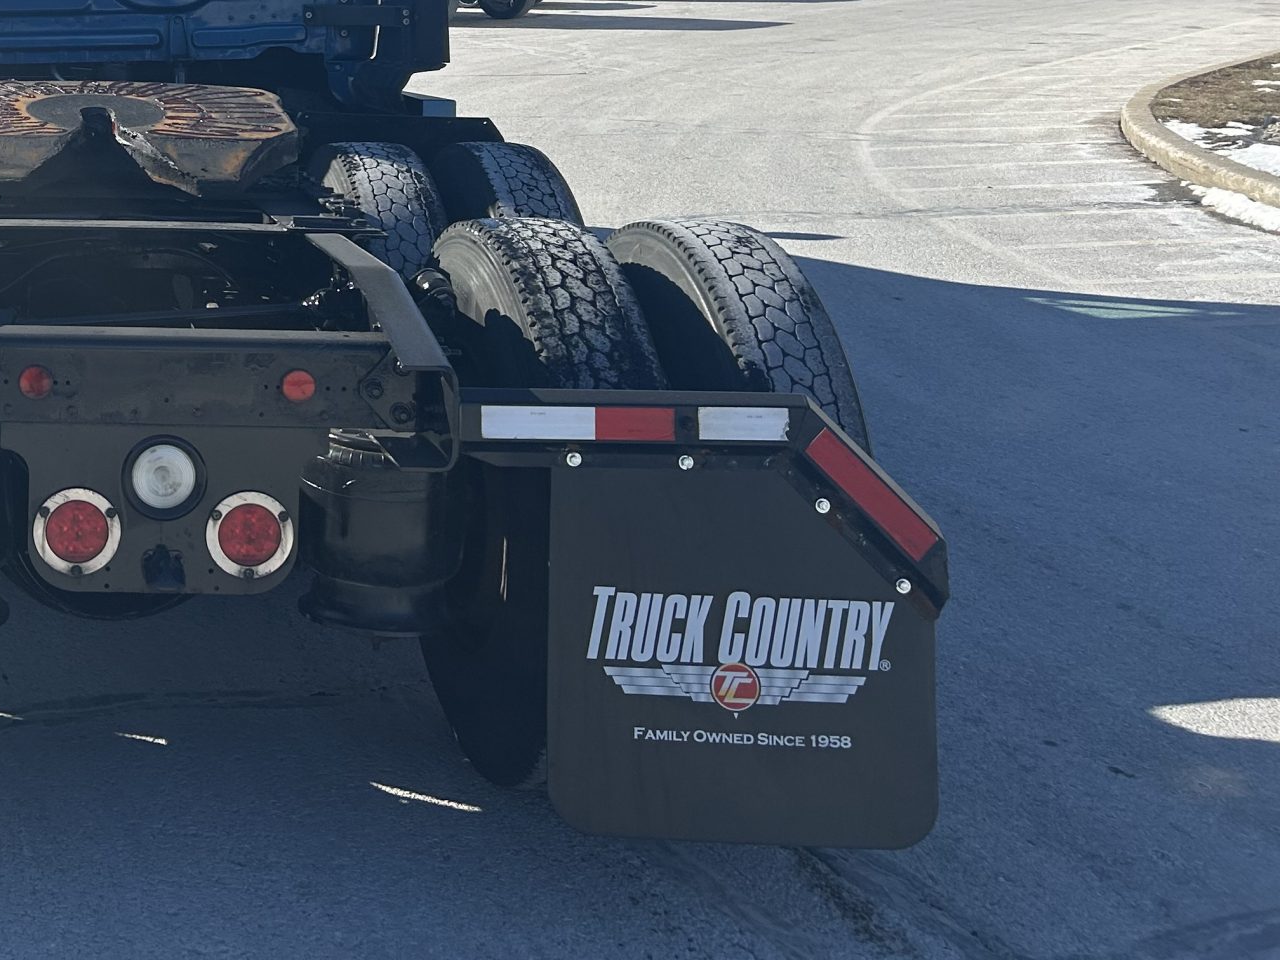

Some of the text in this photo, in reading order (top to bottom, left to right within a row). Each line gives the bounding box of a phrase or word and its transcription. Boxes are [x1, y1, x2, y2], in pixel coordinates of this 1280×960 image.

[586, 585, 895, 671] TRUCK COUNTRY
[633, 726, 852, 749] FAMILY OWNED SINCE 1958
